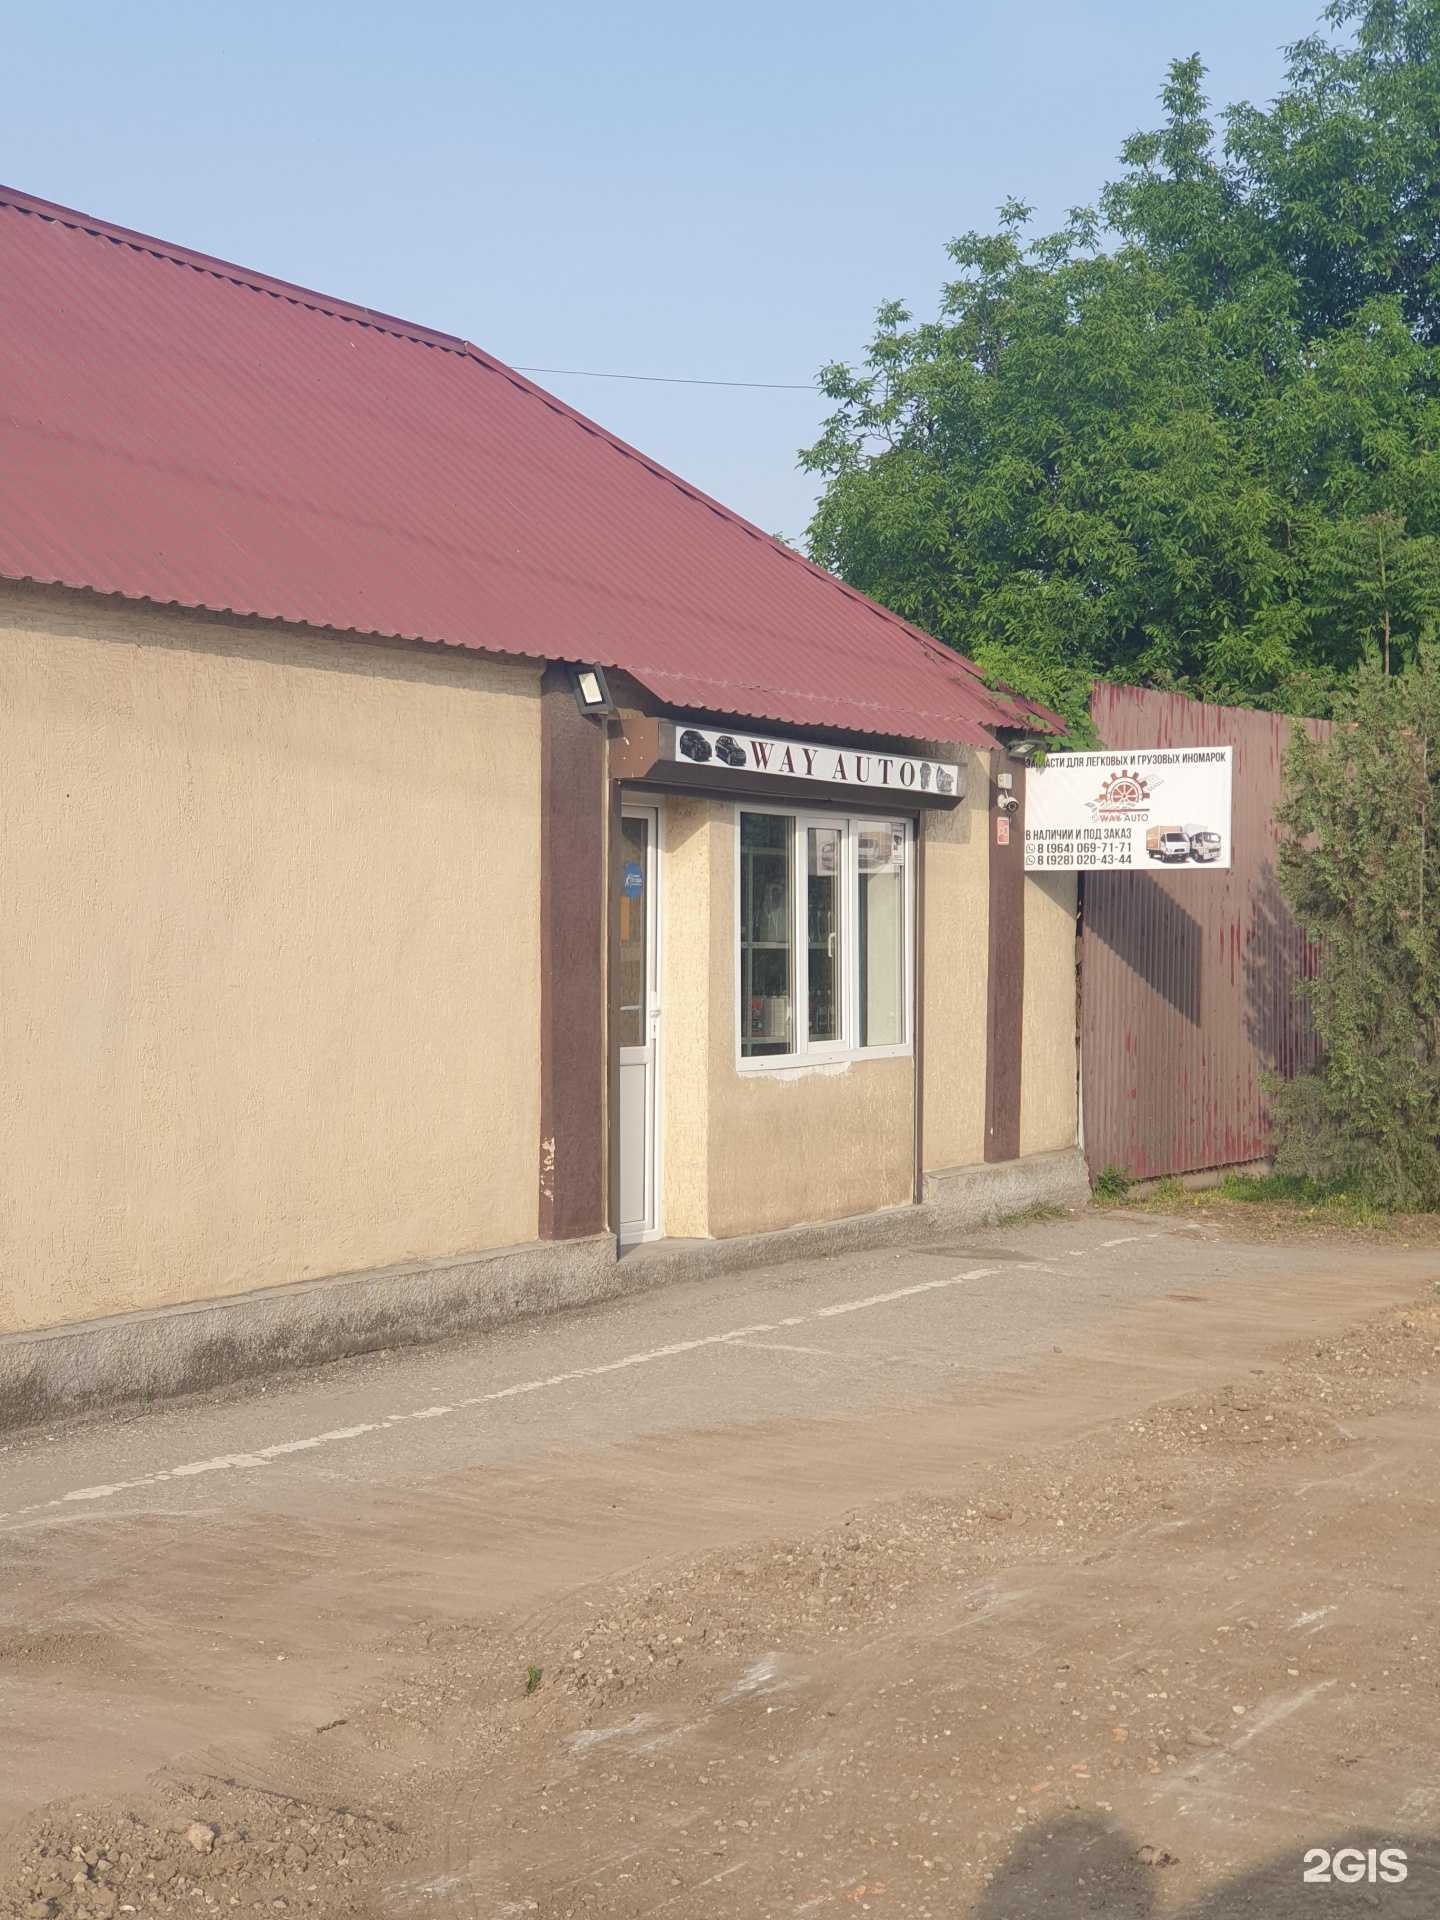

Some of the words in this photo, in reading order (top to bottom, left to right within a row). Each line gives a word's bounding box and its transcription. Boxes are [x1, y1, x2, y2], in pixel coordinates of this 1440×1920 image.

[750, 740, 818, 776] WAY
[832, 755, 916, 787] AUTO
[1066, 757, 1084, 768] ДЛЯ
[1086, 755, 1128, 767] ЛЕГКОВЫХ
[1130, 755, 1135, 765] И
[1137, 753, 1180, 765] ГРУЗОВЫХ
[1182, 752, 1226, 763] ИНОМАРОК
[1124, 813, 1149, 822] AUTO
[1026, 830, 1031, 840] В
[1033, 829, 1073, 840] НАЛИЧИИ
[1075, 828, 1081, 839] И
[1083, 828, 1102, 840] ПОД
[1104, 827, 1132, 839] ЗАКАЗ
[1037, 844, 1044, 853] 8
[1047, 843, 1074, 853] (964)
[1077, 842, 1131, 853] 069-71-71
[1037, 855, 1044, 865] 8
[1047, 855, 1074, 865] (928)
[1077, 854, 1132, 864] 020-43-44
